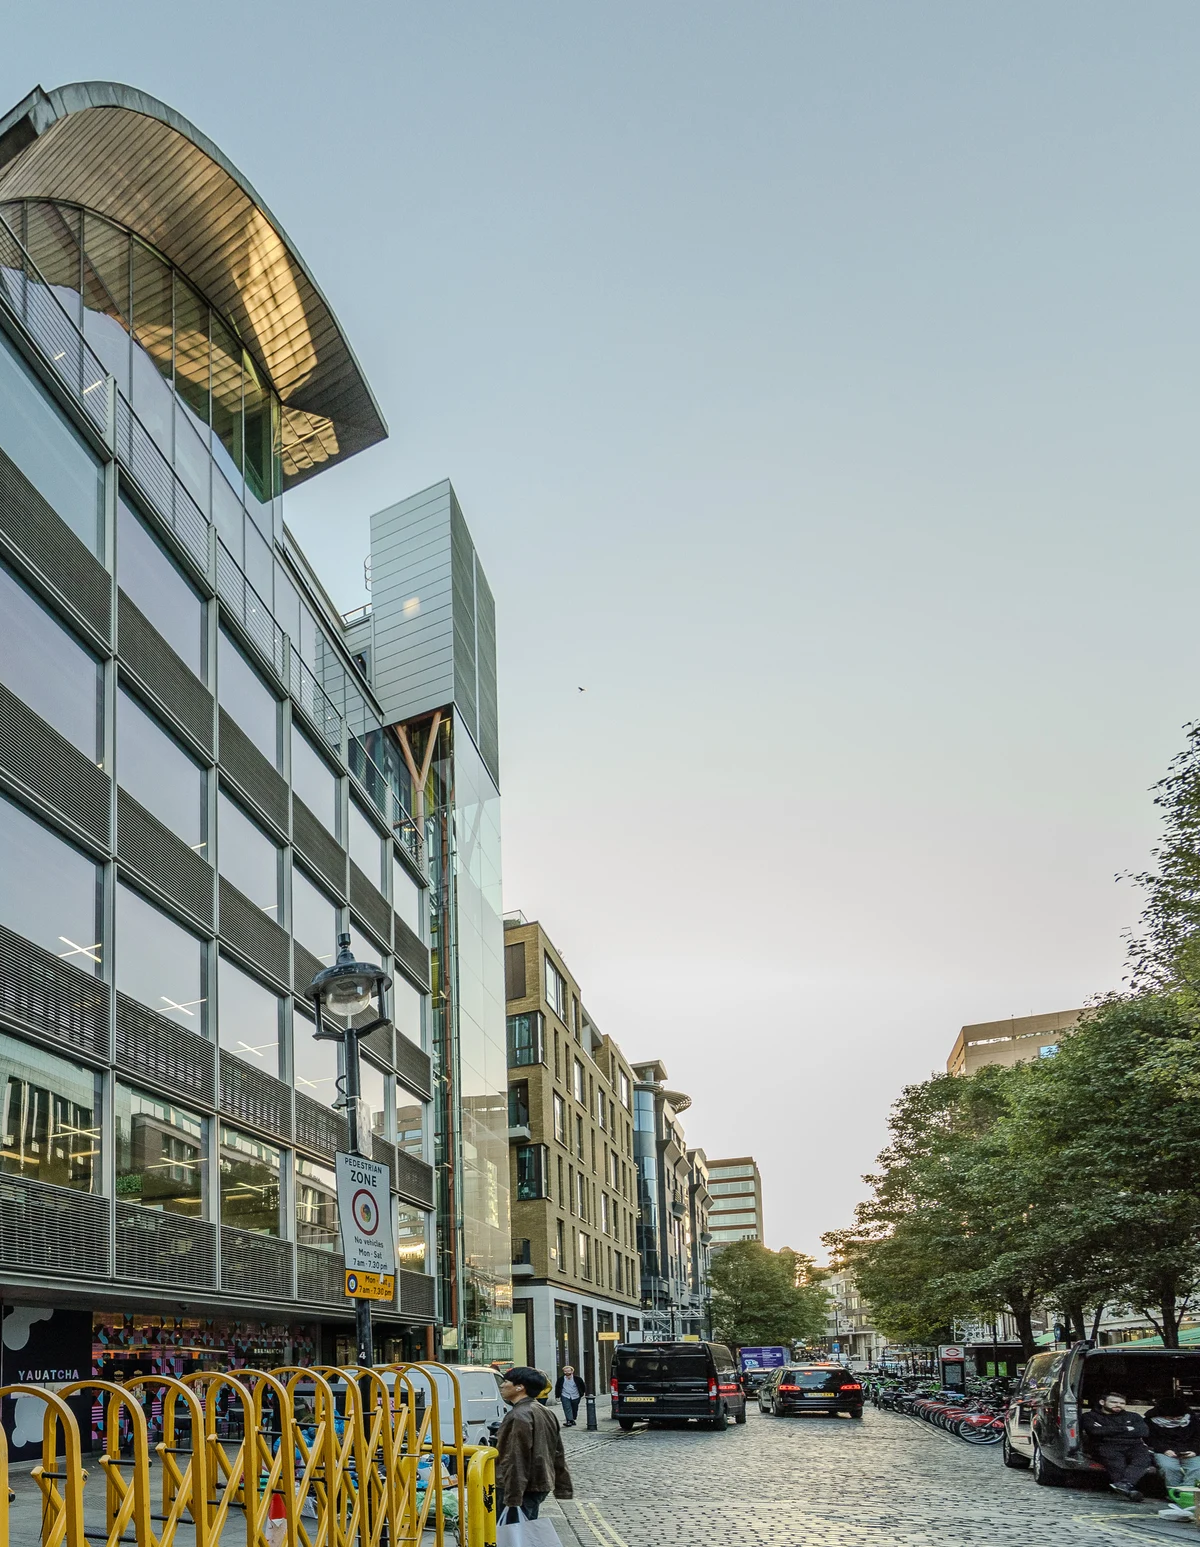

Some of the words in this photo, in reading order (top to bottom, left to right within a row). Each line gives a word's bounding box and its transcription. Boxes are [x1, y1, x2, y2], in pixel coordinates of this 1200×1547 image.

[344, 1157, 382, 1174] PEDESTRIAN
[350, 1170, 377, 1188] ZONE
[354, 1236, 363, 1244] No
[364, 1239, 384, 1248] vehicles
[358, 1248, 370, 1257] Mon
[373, 1251, 382, 1259] Sat
[18, 1369, 79, 1381] YAUATCHA
